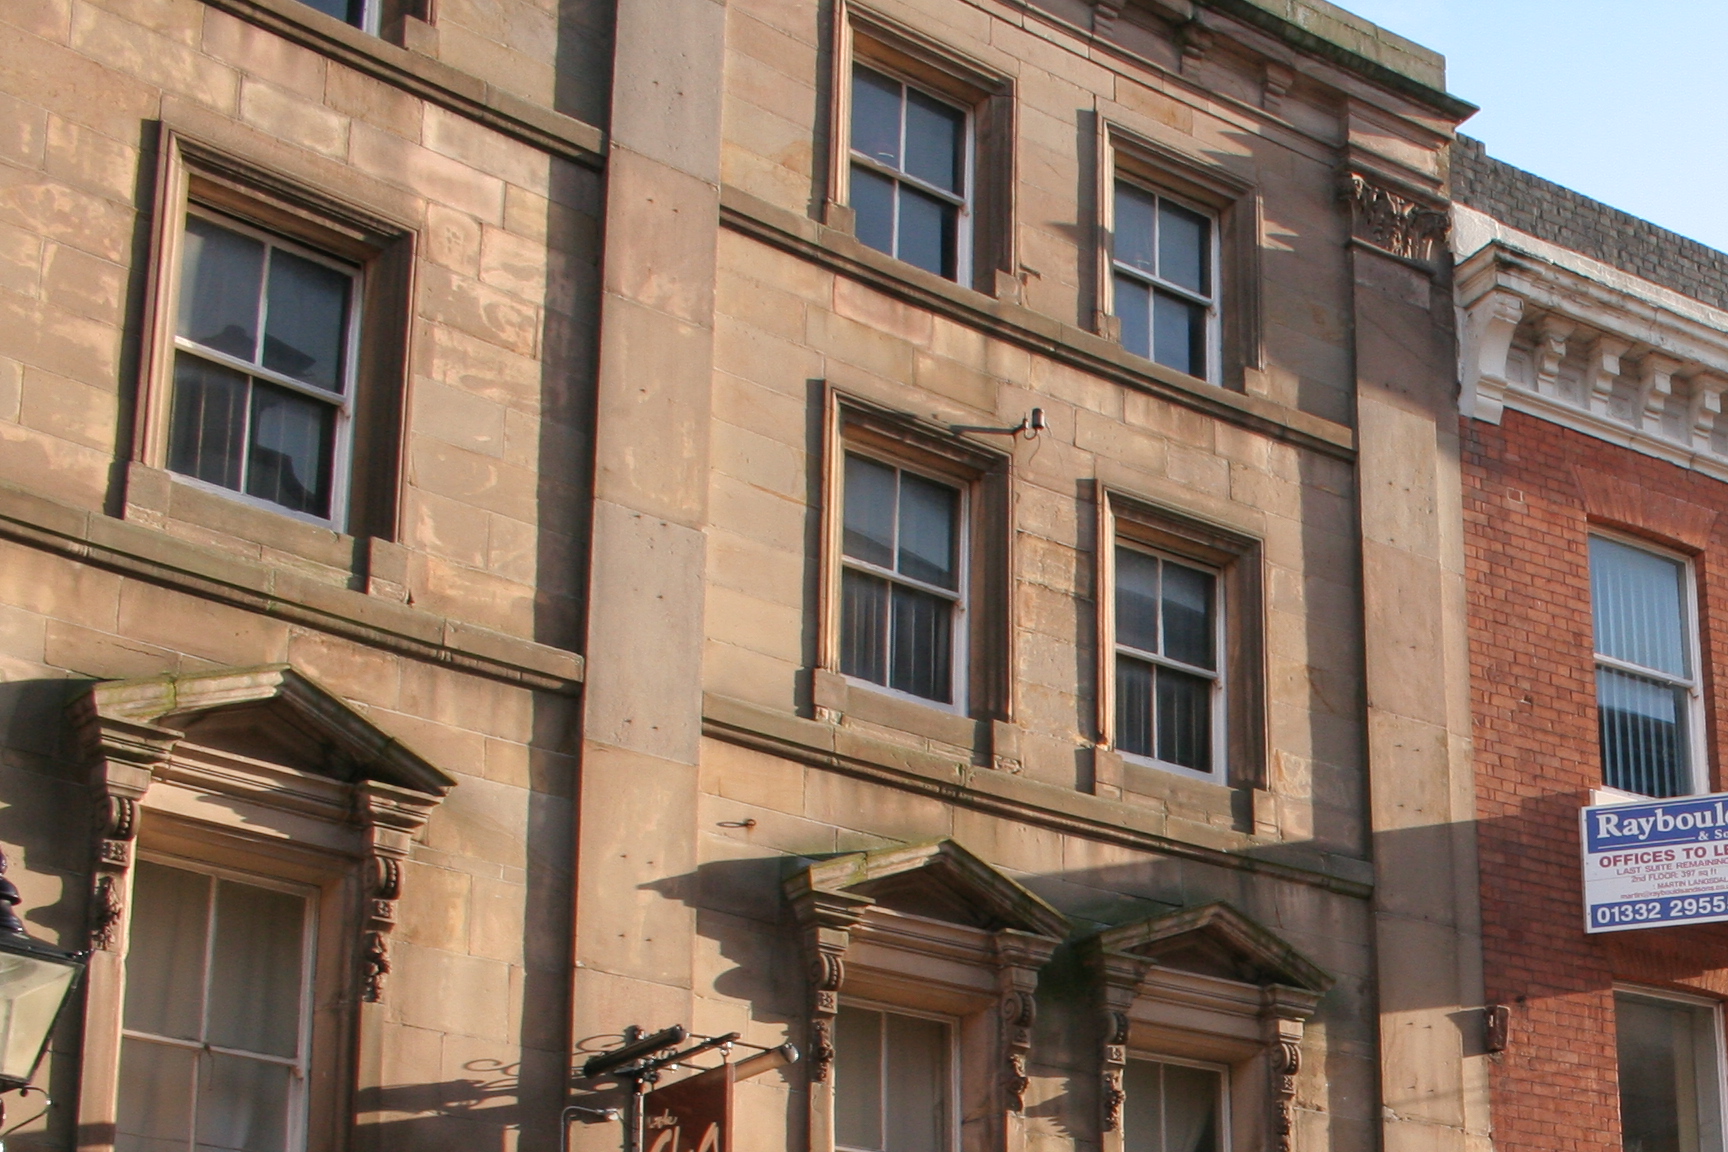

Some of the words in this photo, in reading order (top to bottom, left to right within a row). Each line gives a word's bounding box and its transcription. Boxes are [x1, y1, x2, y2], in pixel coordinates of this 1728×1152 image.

[1697, 831, 1709, 841] &
[1599, 849, 1676, 868] OFFICES
[1682, 846, 1707, 860] TO
[1616, 865, 1641, 876] LAST
[1645, 863, 1673, 873] SUITE
[1631, 874, 1647, 883] 2nd
[1681, 869, 1696, 878] 397
[1657, 880, 1687, 890] MARTIN
[1596, 901, 1662, 924] 01332
